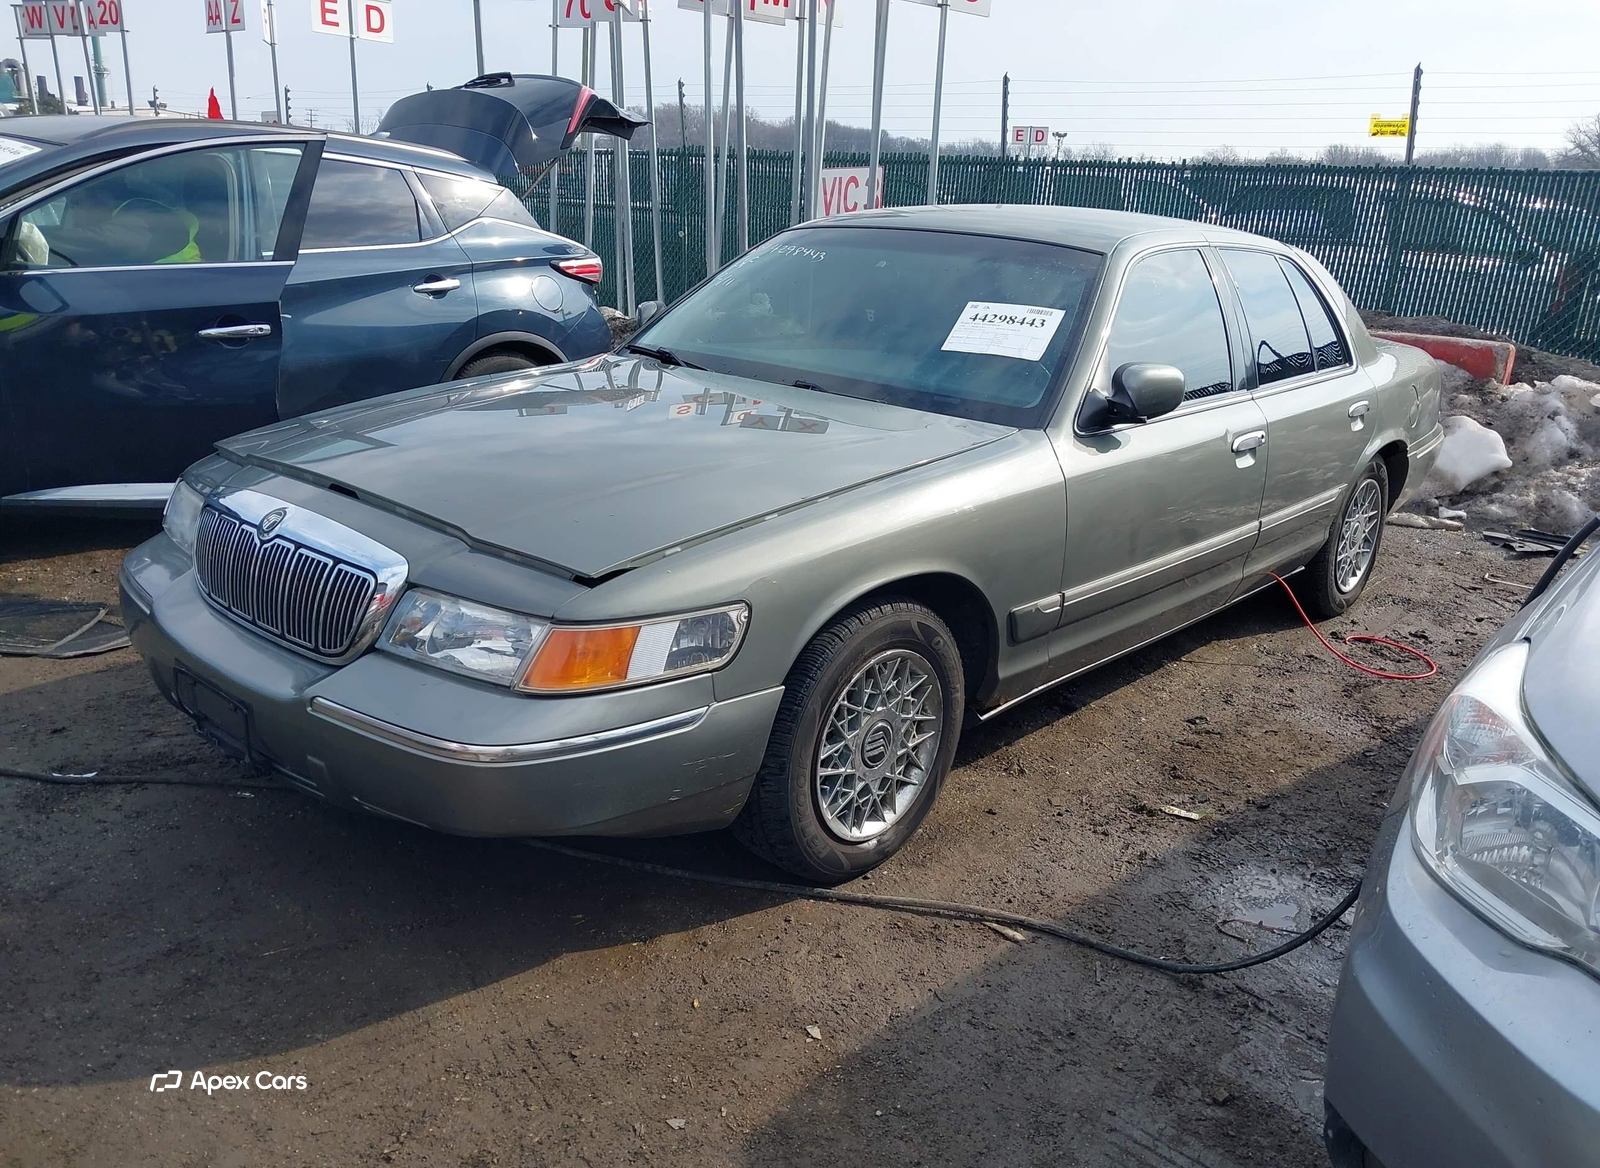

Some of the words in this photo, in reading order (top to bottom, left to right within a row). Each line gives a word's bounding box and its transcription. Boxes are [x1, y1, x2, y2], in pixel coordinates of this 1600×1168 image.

[25, 5, 43, 29] W
[53, 5, 65, 29] V
[97, 0, 119, 25] 20
[207, 1, 222, 27] AA
[230, 0, 241, 24] Z
[321, 0, 340, 27] E
[365, 4, 385, 34] D
[1015, 129, 1025, 142] E
[1034, 129, 1045, 142] D
[821, 175, 860, 217] VIC
[968, 311, 1047, 329] 44298443
